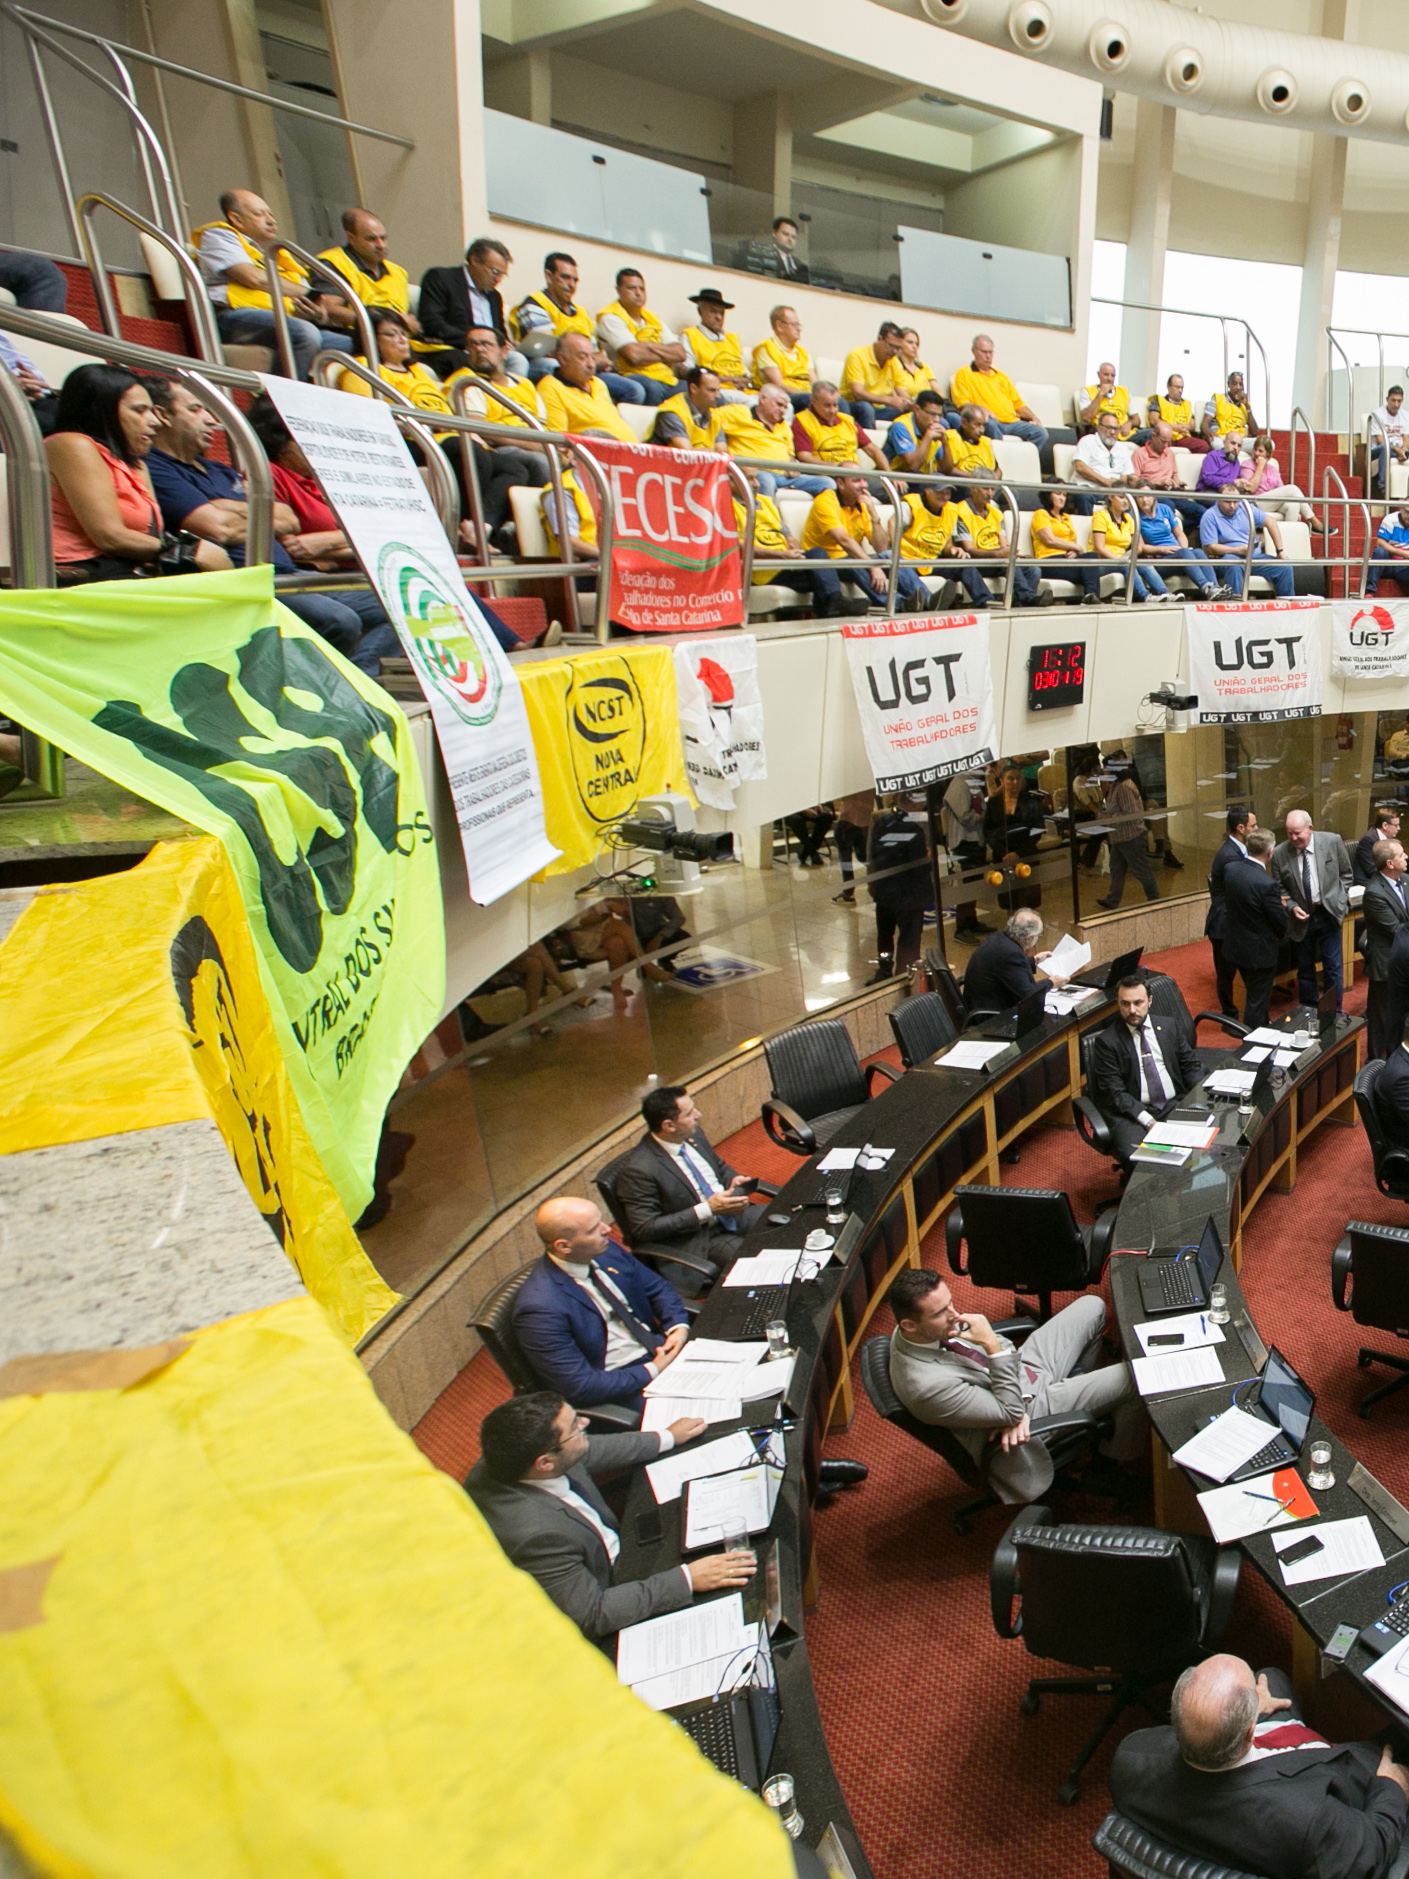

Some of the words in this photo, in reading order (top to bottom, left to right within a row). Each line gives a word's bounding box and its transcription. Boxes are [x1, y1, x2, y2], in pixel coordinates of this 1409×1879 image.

[658, 575, 675, 589] dos
[673, 595, 686, 607] no
[642, 610, 653, 625] de
[654, 610, 680, 625] Santa
[681, 608, 722, 625] Catarina
[848, 624, 870, 635] UGT
[870, 623, 891, 633] UGT
[891, 621, 911, 633] UGT
[911, 619, 930, 629] UGT
[930, 616, 950, 627] UGT
[950, 615, 970, 624] UGT
[1349, 630, 1394, 647] UGT
[1213, 635, 1303, 671] UGT
[866, 652, 963, 710] UGT
[1214, 676, 1246, 687] UNIÃO
[1250, 675, 1283, 685] GERAL
[1287, 672, 1307, 681] DOS
[1216, 680, 1307, 696] TRABALHADORES
[583, 695, 625, 724] NCST
[1202, 713, 1226, 723] UGT
[1231, 713, 1253, 722] UGT
[1258, 711, 1279, 720] UGT
[1284, 708, 1304, 718] UGT
[883, 719, 913, 735] UNIÃO
[917, 713, 950, 729] GERAL
[952, 707, 979, 720] DOS
[890, 722, 977, 751] TRABALHADORES
[594, 749, 626, 771] NOVA
[880, 778, 903, 792] UGT
[905, 774, 920, 787] UGT
[922, 769, 937, 783] UGT
[937, 764, 953, 778] UGT
[953, 759, 969, 772] UGT
[968, 752, 986, 767] UGT
[345, 926, 383, 995] DOS
